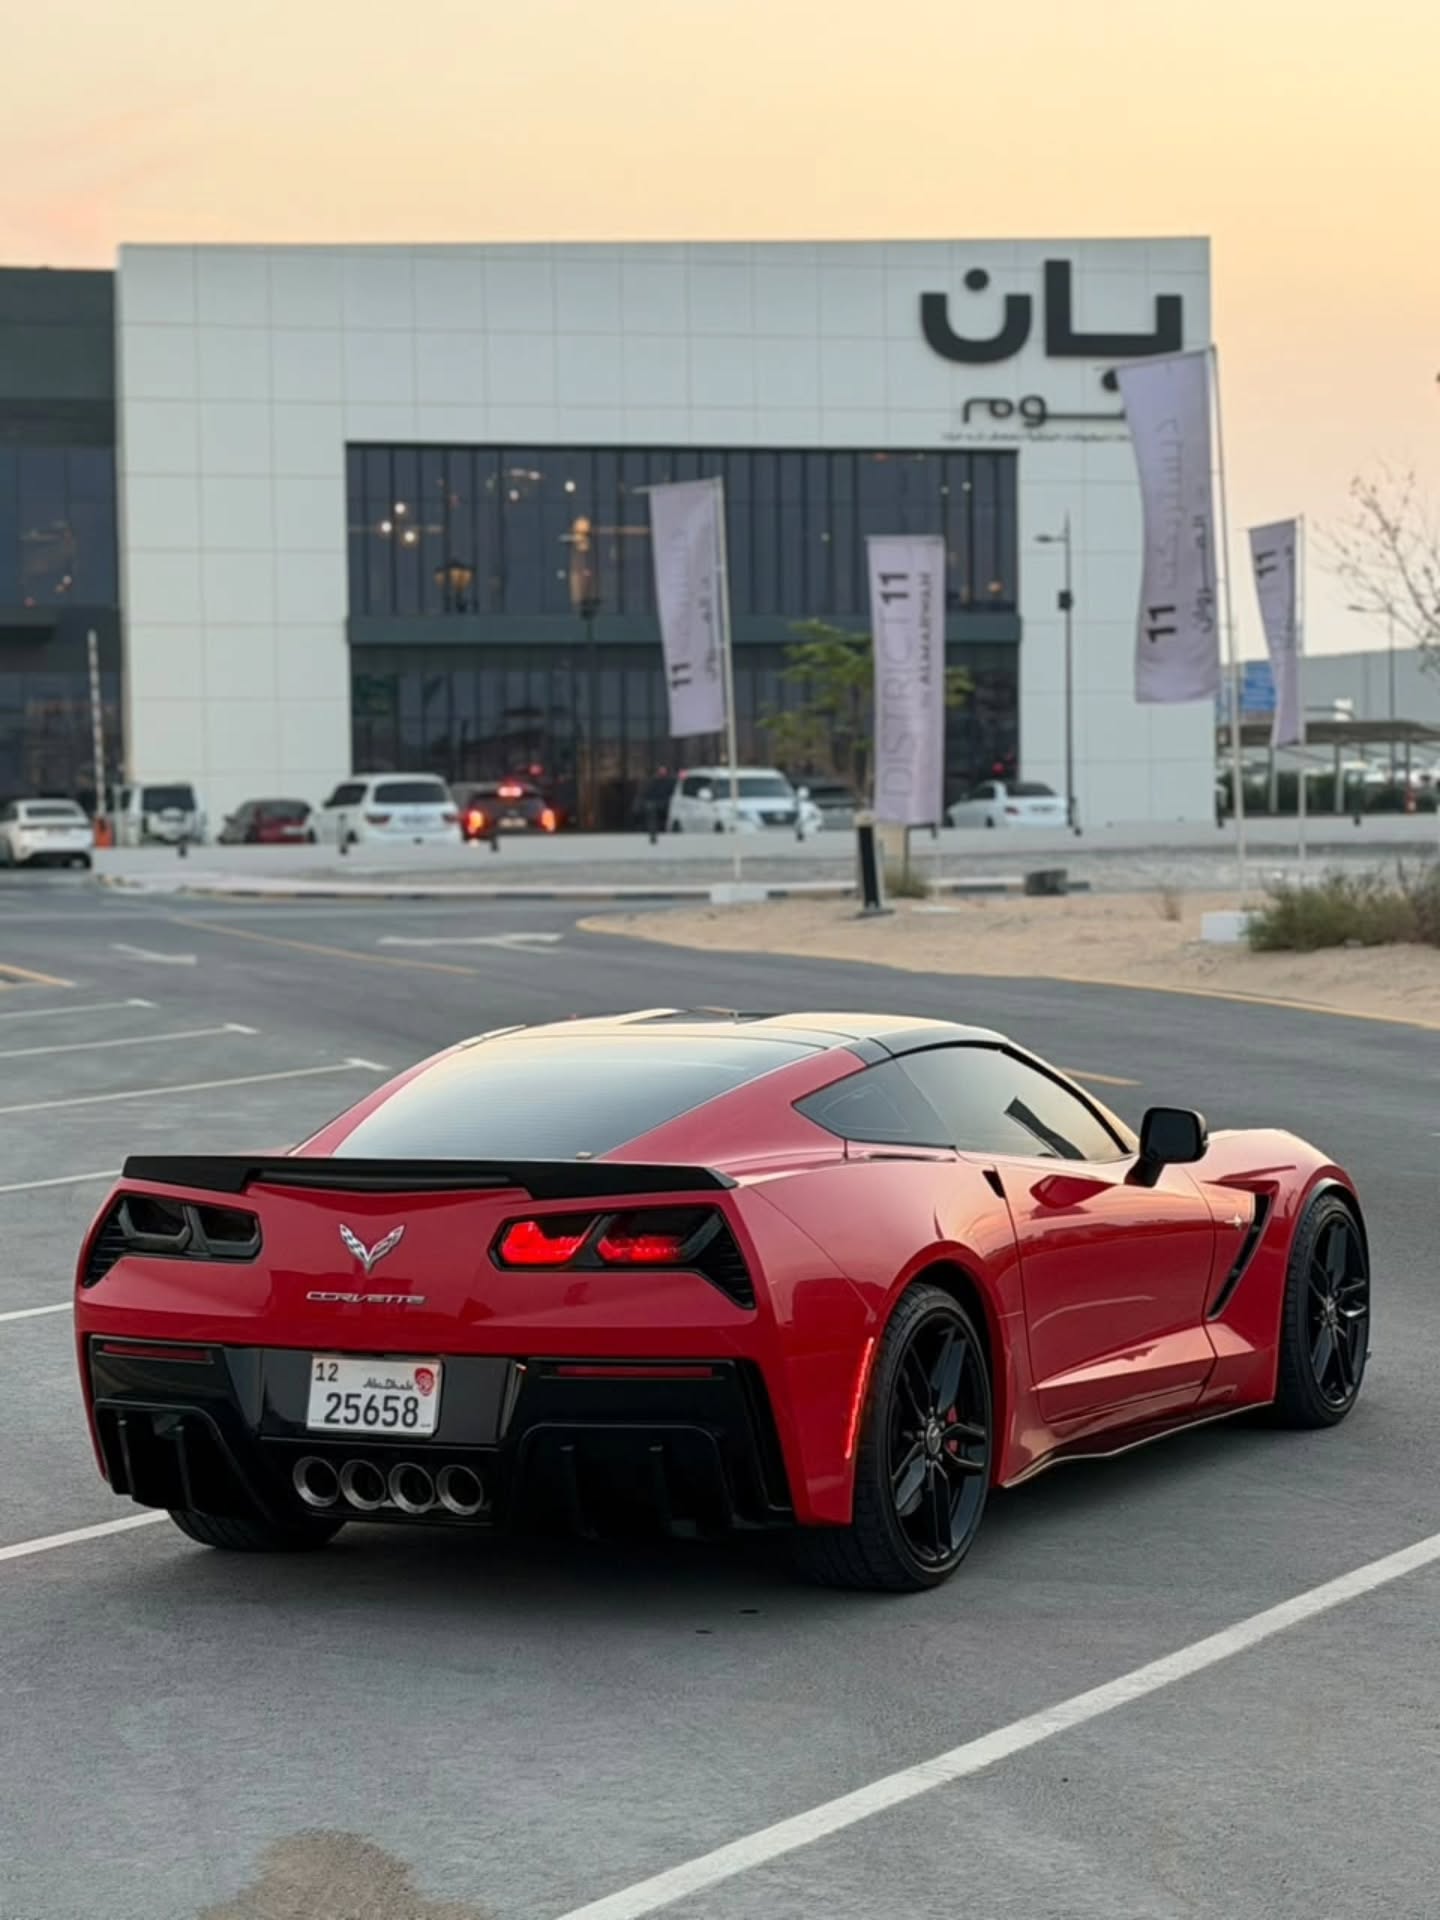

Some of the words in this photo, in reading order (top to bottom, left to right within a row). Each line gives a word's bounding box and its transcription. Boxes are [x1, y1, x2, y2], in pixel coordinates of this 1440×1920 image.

[1255, 549, 1278, 580] 11
[878, 571, 909, 605] 11
[1146, 605, 1177, 643] 11
[671, 663, 692, 689] 11
[880, 610, 913, 797] DISTRICT
[306, 1290, 425, 1304] CORVETTE
[315, 1362, 339, 1382] 12
[324, 1392, 419, 1428] 25658
